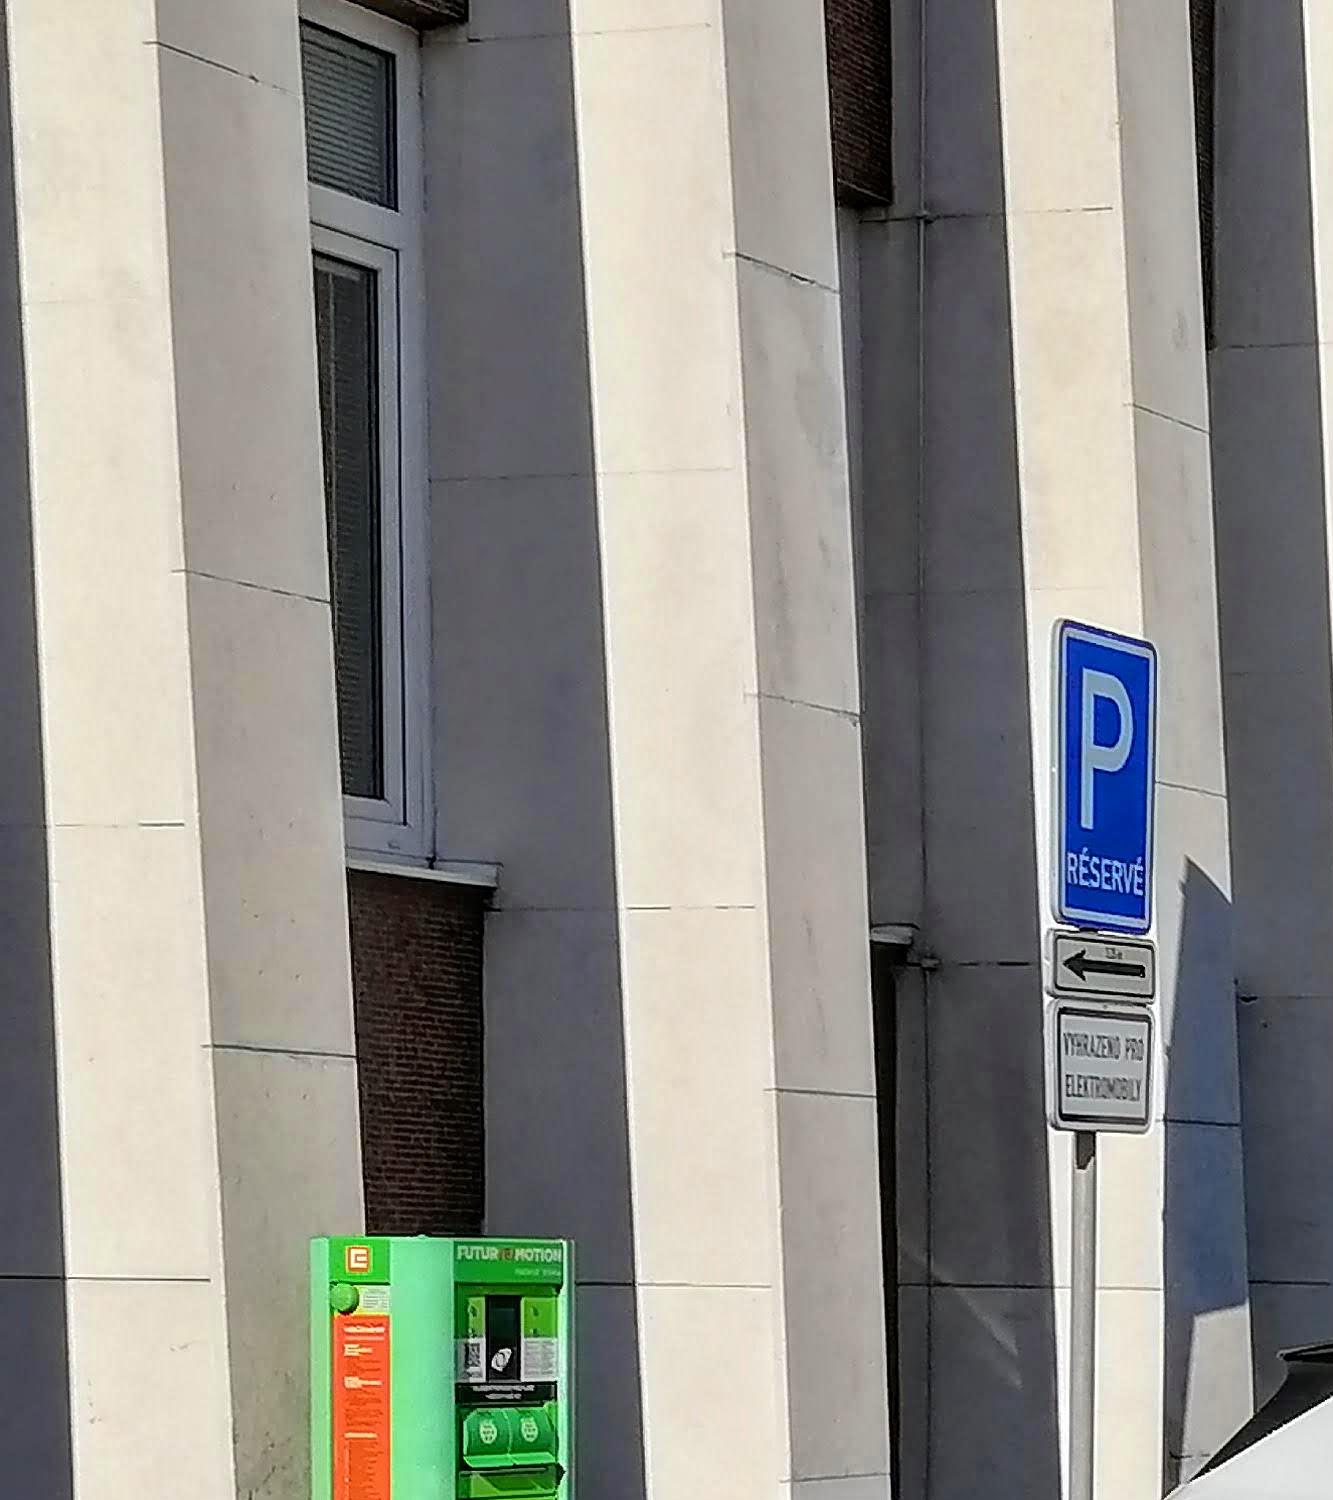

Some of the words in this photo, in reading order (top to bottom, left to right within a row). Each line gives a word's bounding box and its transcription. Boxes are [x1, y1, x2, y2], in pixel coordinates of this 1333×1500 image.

[1081, 667, 1135, 830] P
[1066, 846, 1145, 897] RÉSERVÉ
[1125, 1037, 1144, 1061] PRO
